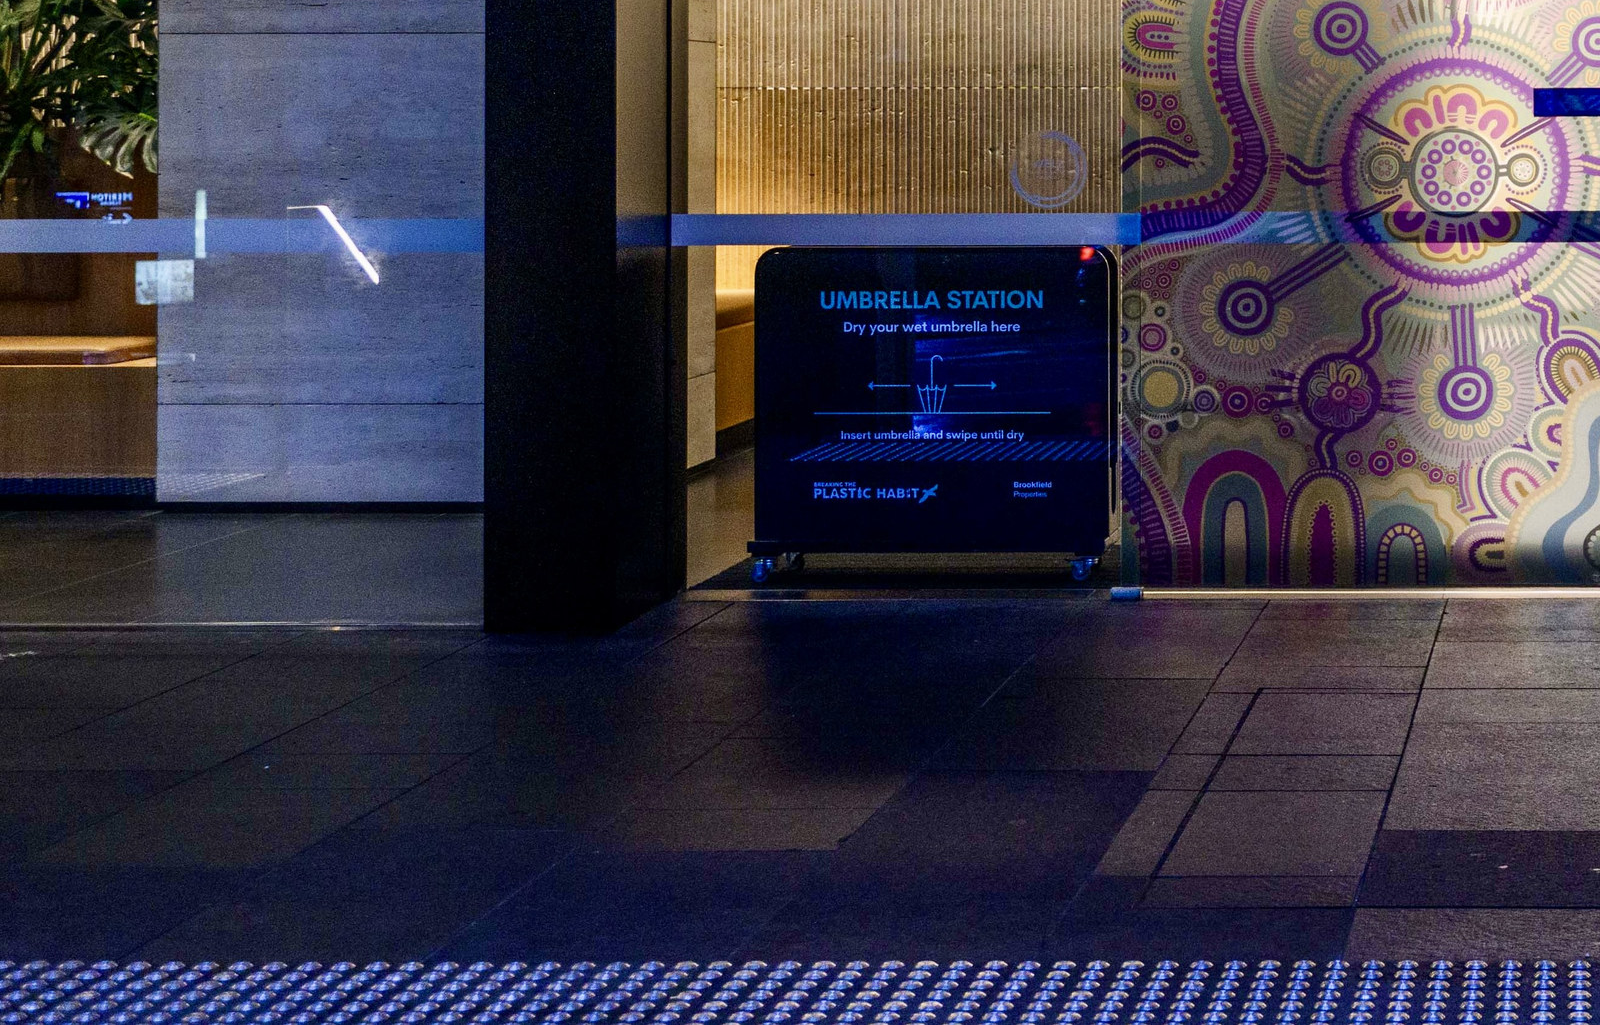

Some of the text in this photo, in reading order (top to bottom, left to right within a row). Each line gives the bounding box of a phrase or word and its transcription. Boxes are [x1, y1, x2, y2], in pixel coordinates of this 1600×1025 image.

[820, 290, 1044, 309] UMBRELLA STATION
[843, 321, 1021, 335] Dry your wet umbrella here
[840, 430, 1025, 442] Insert umbrella and swipe until dry
[1013, 481, 1053, 489] Brookfield
[813, 486, 920, 499] PLASTIC HABIT
